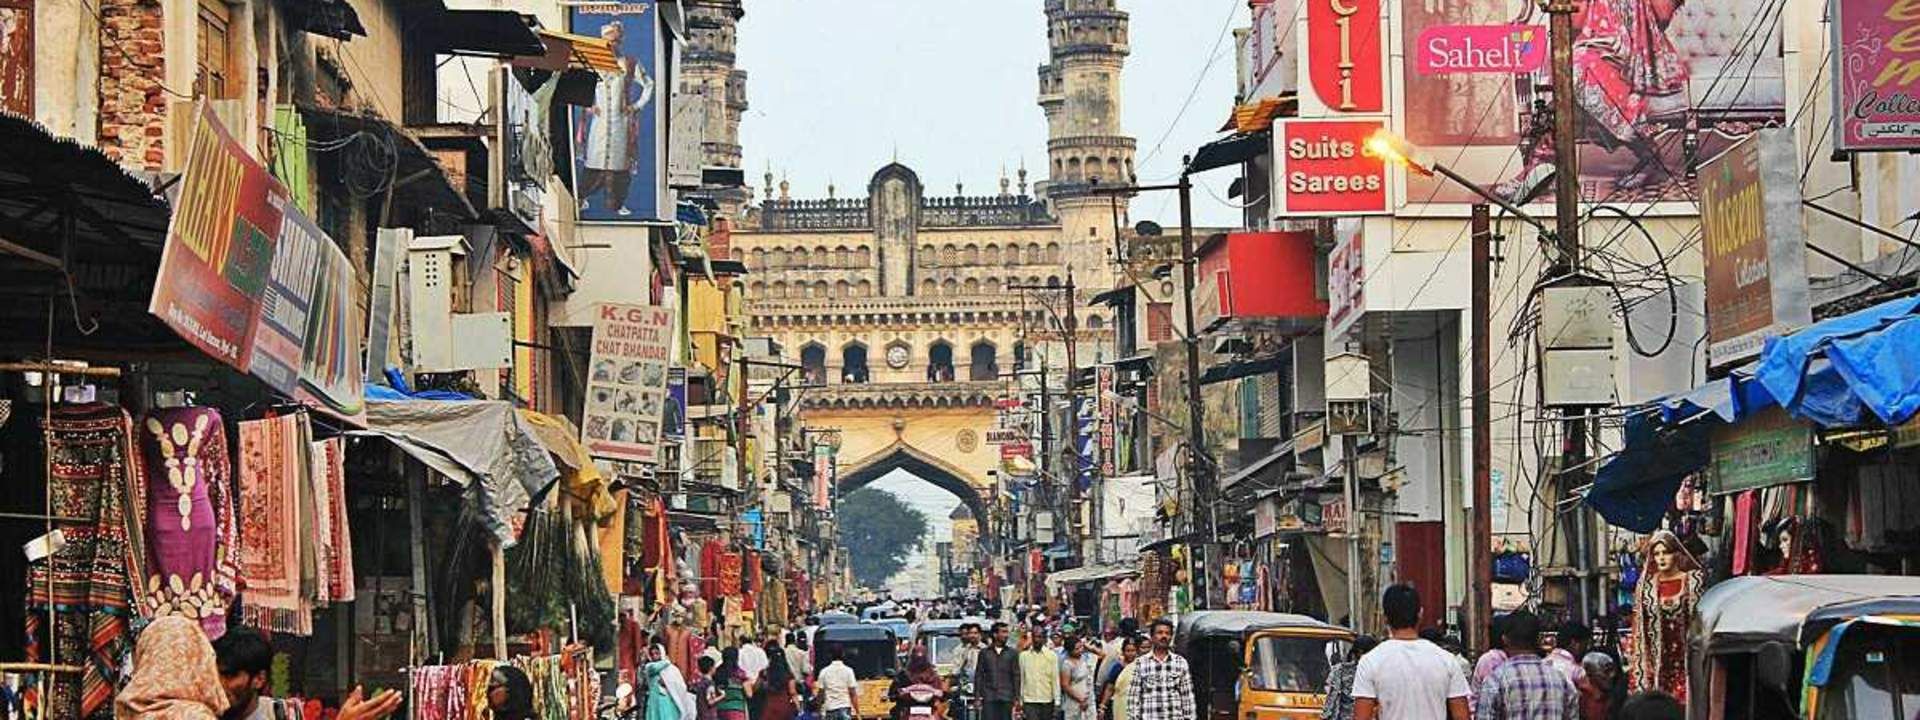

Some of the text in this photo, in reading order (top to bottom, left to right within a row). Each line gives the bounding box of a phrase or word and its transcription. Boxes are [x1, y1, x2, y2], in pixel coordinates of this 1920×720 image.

[1429, 35, 1524, 68] Saheli
[1289, 134, 1354, 159] Suits
[1289, 171, 1380, 193] Sarees
[601, 304, 668, 326] K.G.N
[596, 339, 621, 356] CHAT
